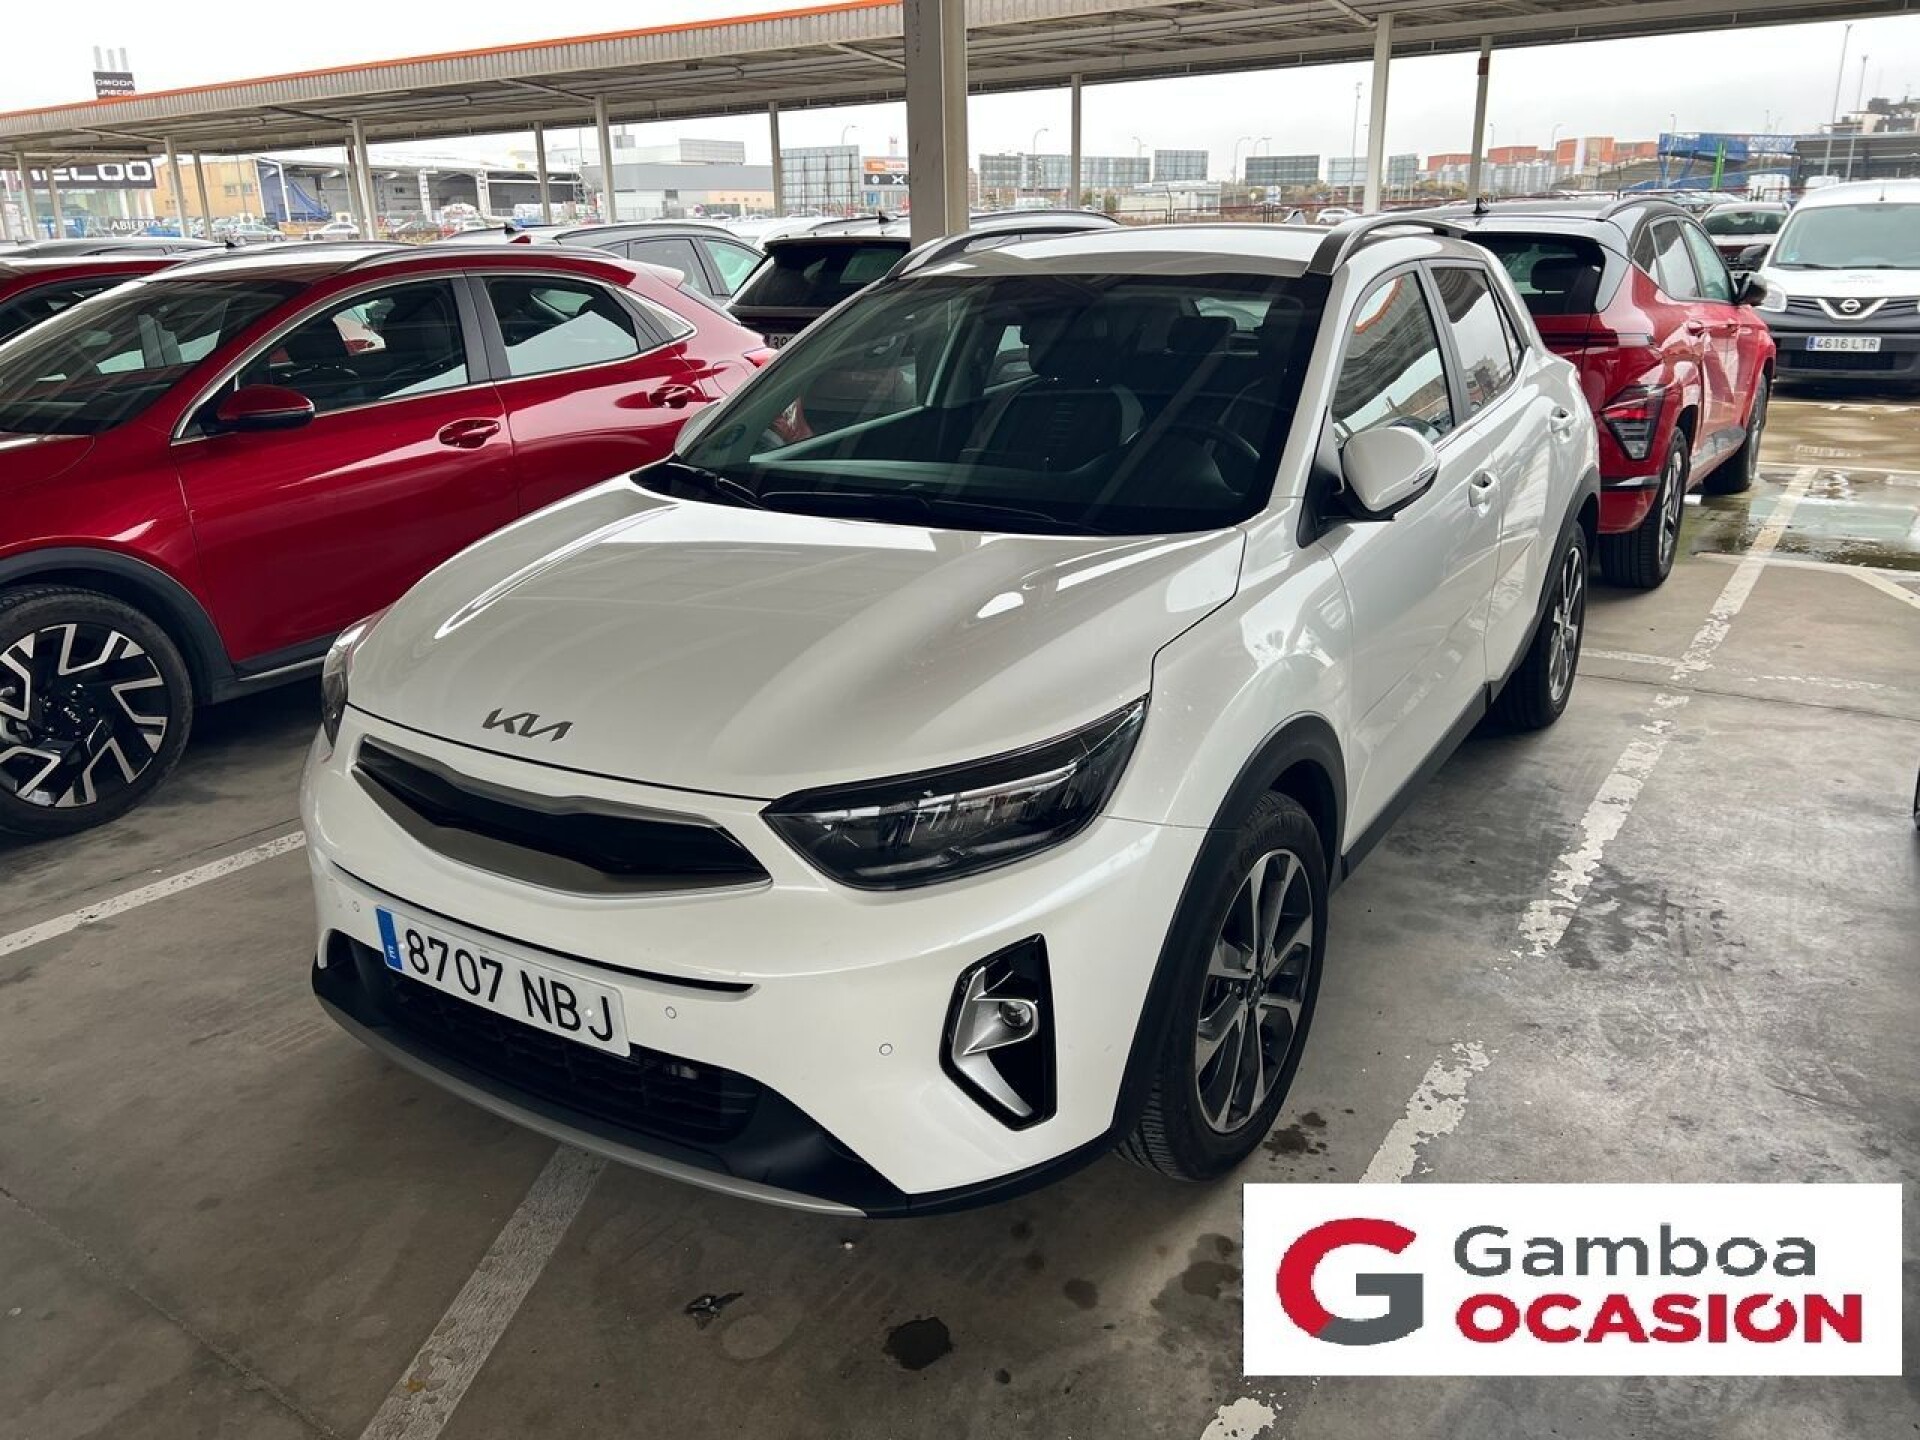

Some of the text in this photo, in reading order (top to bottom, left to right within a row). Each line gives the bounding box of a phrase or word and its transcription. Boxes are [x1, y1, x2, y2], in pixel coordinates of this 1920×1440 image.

[1817, 338, 1849, 349] 4616
[1851, 338, 1877, 350] LTR
[482, 708, 573, 742] KIA
[405, 928, 613, 1042] 8707 NBJ
